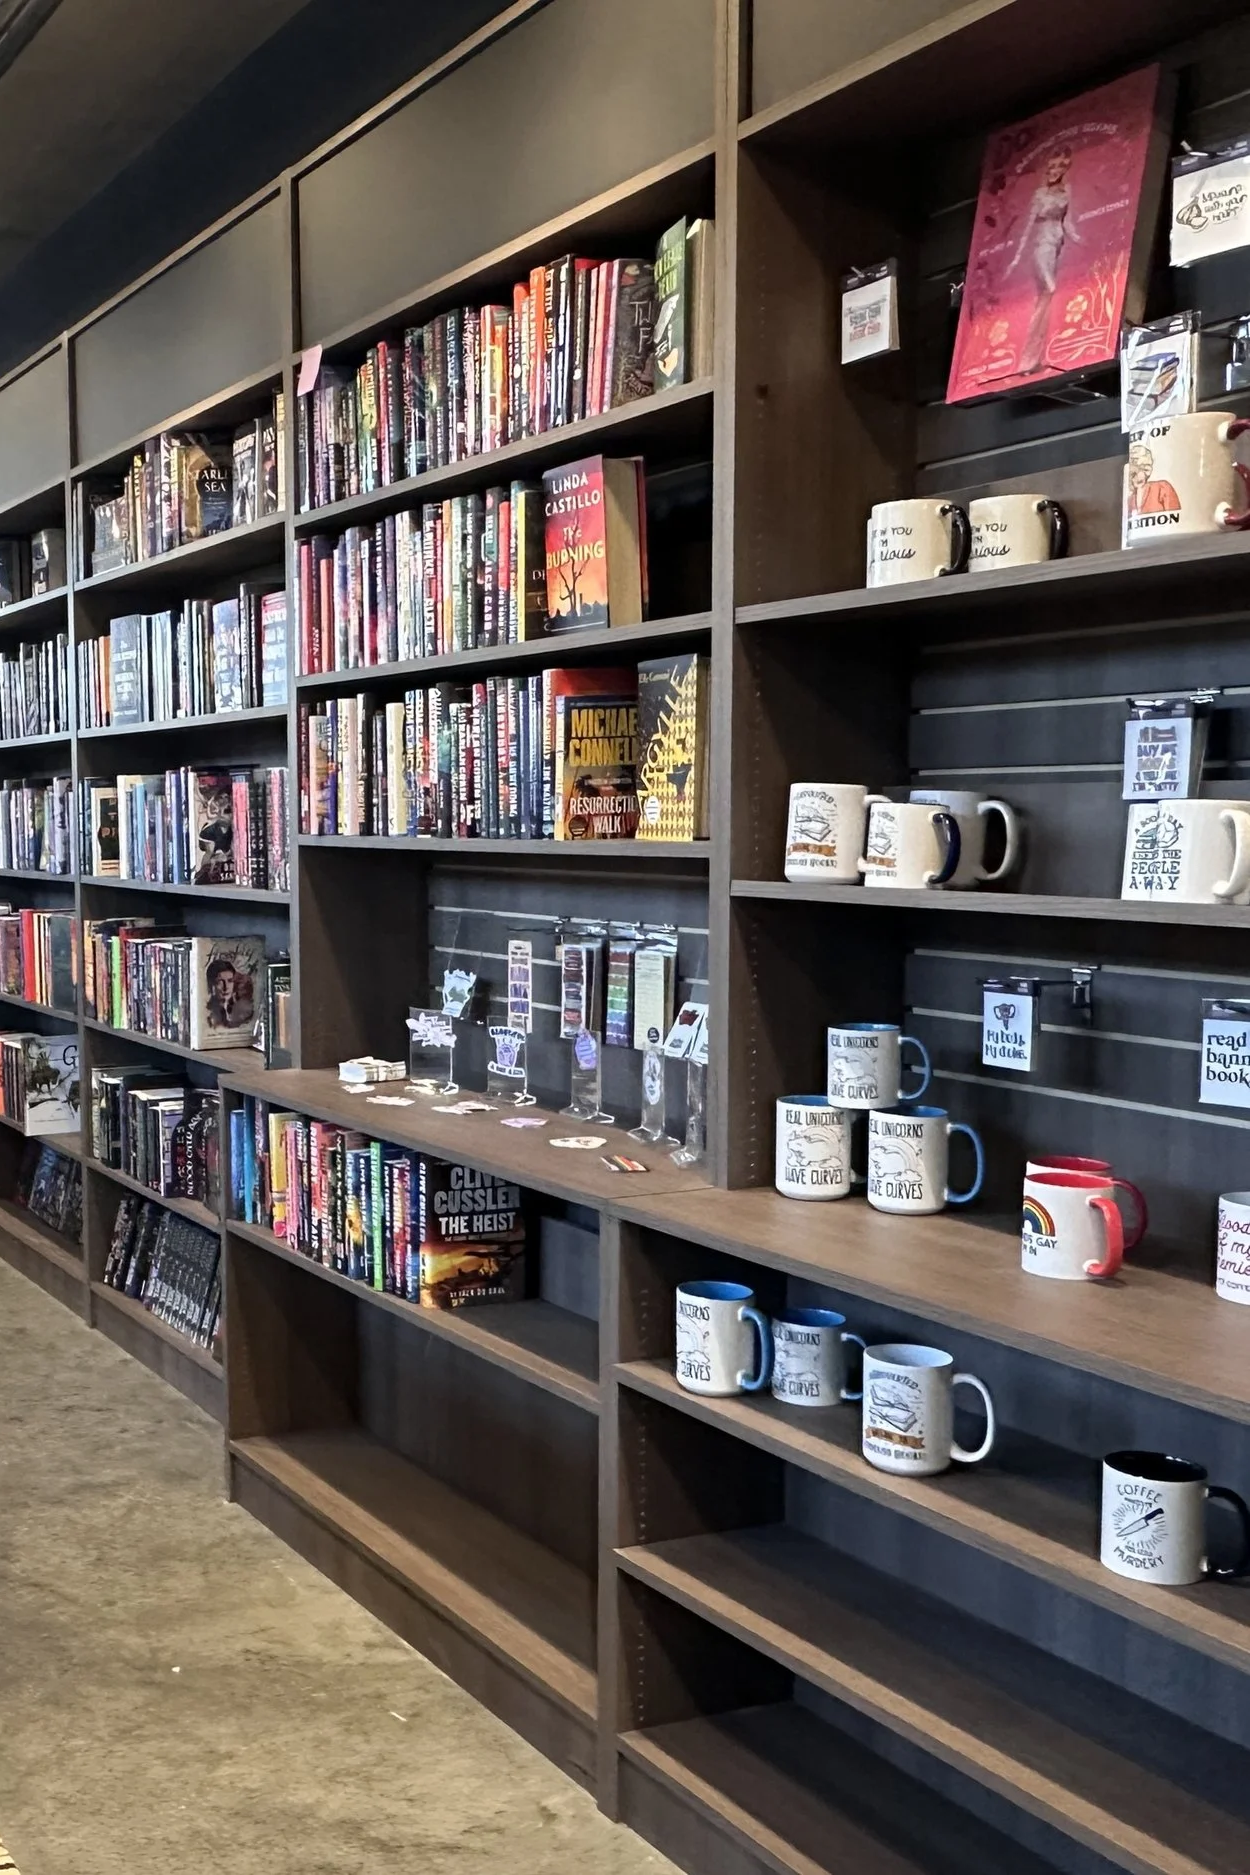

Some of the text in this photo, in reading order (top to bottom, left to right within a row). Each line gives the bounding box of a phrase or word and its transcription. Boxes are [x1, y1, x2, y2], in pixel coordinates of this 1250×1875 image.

[1150, 425, 1171, 438] OF
[204, 481, 227, 492] SEA
[552, 471, 589, 495] LINDA
[545, 490, 602, 517] CASTILLO
[891, 526, 913, 536] YOU
[986, 523, 1008, 533] YOU
[546, 540, 606, 570] BURNING
[571, 708, 638, 738] MICHAE
[569, 737, 638, 767] CONNEL
[593, 815, 622, 834] WALK
[1207, 1032, 1247, 1051] read
[1206, 1048, 1250, 1069] bann
[1206, 1066, 1250, 1088] book
[881, 1121, 924, 1138] UNICORNS
[450, 1166, 508, 1189] CLIV
[310, 1127, 319, 1250] ROBERT CRAIS
[433, 1186, 521, 1214] CUSSLER
[439, 1212, 517, 1235] THE HEIST
[1036, 1237, 1057, 1249] GAY
[1117, 1484, 1163, 1504] COFFEE
